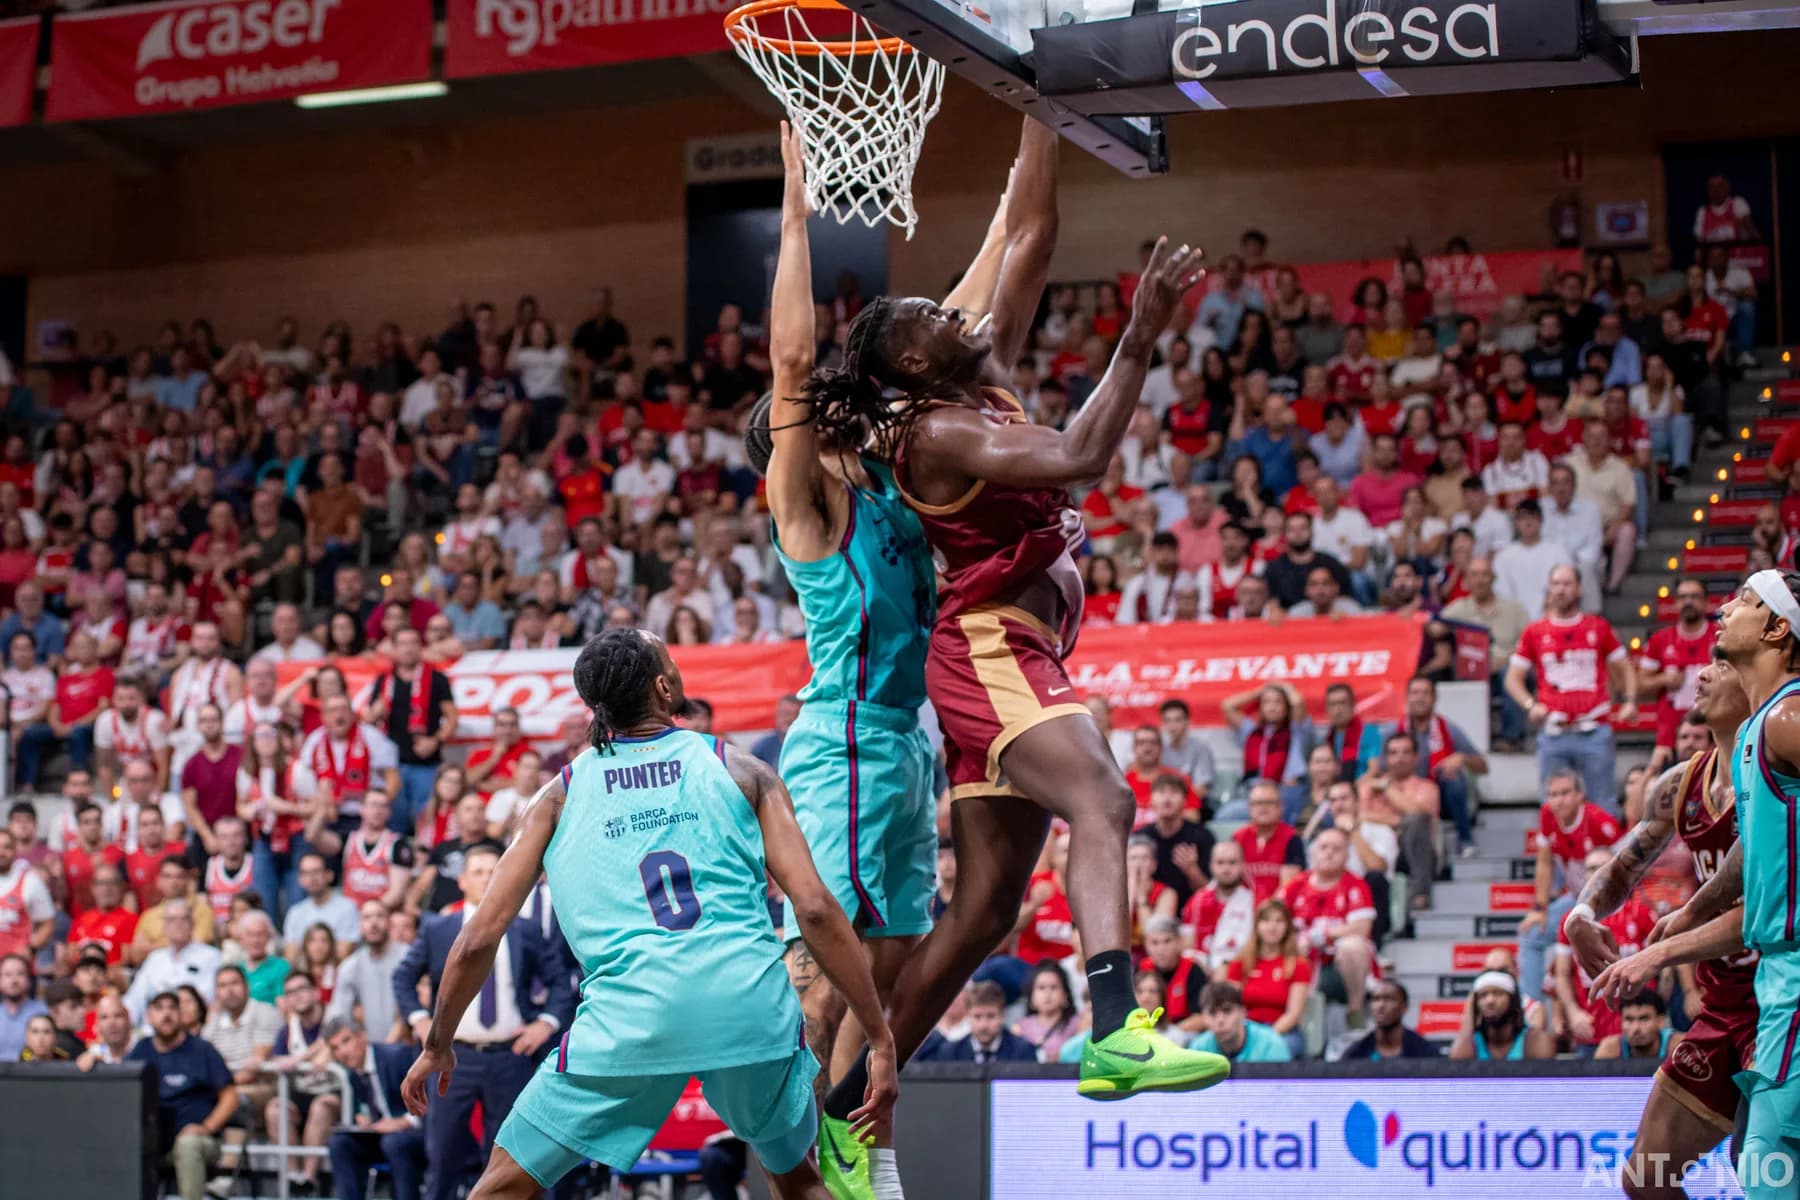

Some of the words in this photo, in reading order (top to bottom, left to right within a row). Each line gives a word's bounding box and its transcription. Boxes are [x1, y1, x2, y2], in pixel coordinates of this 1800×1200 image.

[175, 0, 342, 59] caser
[1171, 0, 1500, 79] endesa
[135, 75, 220, 108] Grupo
[224, 56, 339, 96] Helvetia
[1171, 650, 1391, 690] LEVANTE
[604, 759, 683, 795] PUNTER
[630, 807, 667, 823] BARÇA
[632, 811, 699, 833] FOUNDATION
[638, 850, 702, 931] 0
[1085, 1120, 1318, 1182] Hospital
